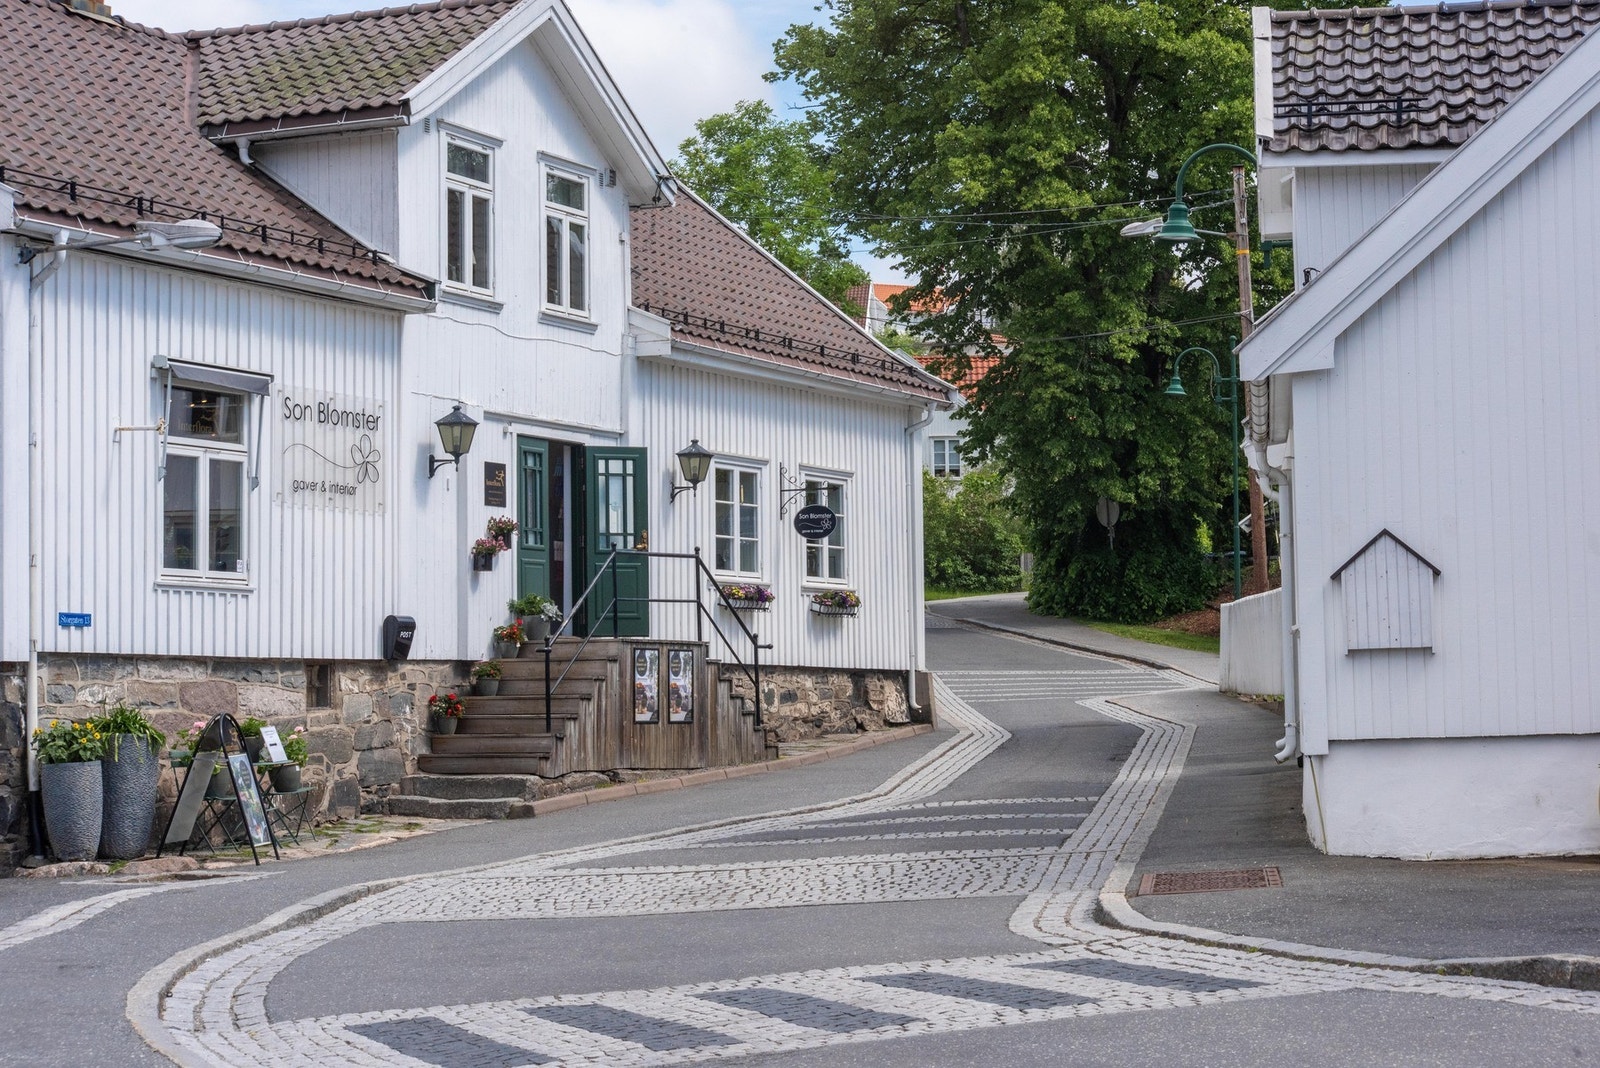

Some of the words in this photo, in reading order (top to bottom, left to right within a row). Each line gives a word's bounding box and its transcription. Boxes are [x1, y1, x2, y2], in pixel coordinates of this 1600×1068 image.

[283, 396, 313, 422] Son
[318, 401, 381, 431] Blomster
[292, 479, 318, 493] gaver
[320, 480, 327, 493] &
[328, 480, 358, 496] interiør
[810, 512, 832, 520] Blomster
